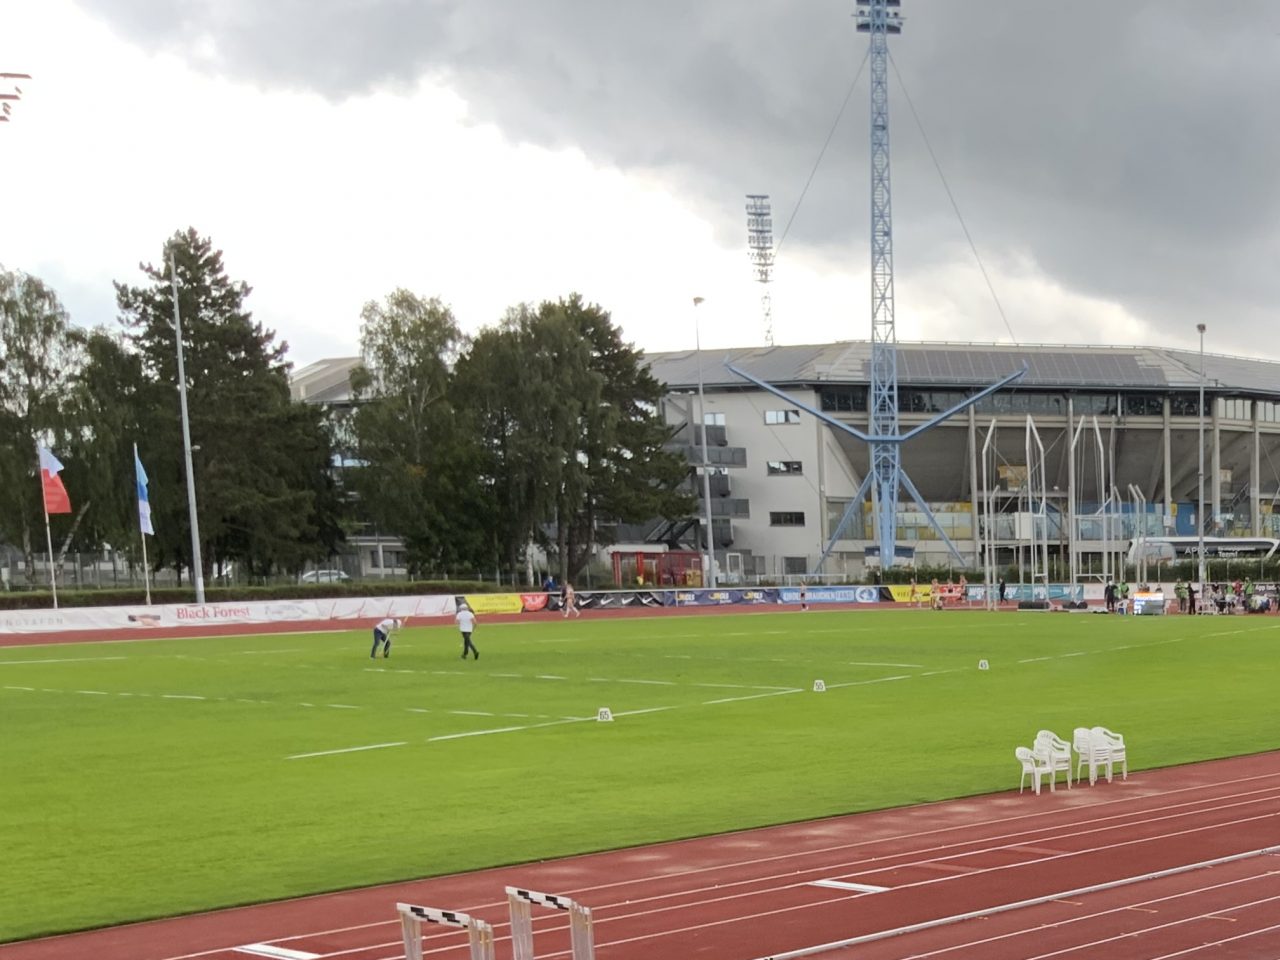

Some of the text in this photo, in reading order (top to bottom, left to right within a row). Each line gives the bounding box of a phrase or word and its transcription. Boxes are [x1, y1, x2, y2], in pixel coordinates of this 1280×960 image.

[176, 606, 251, 619] Black Forest
[599, 710, 610, 721] 65
